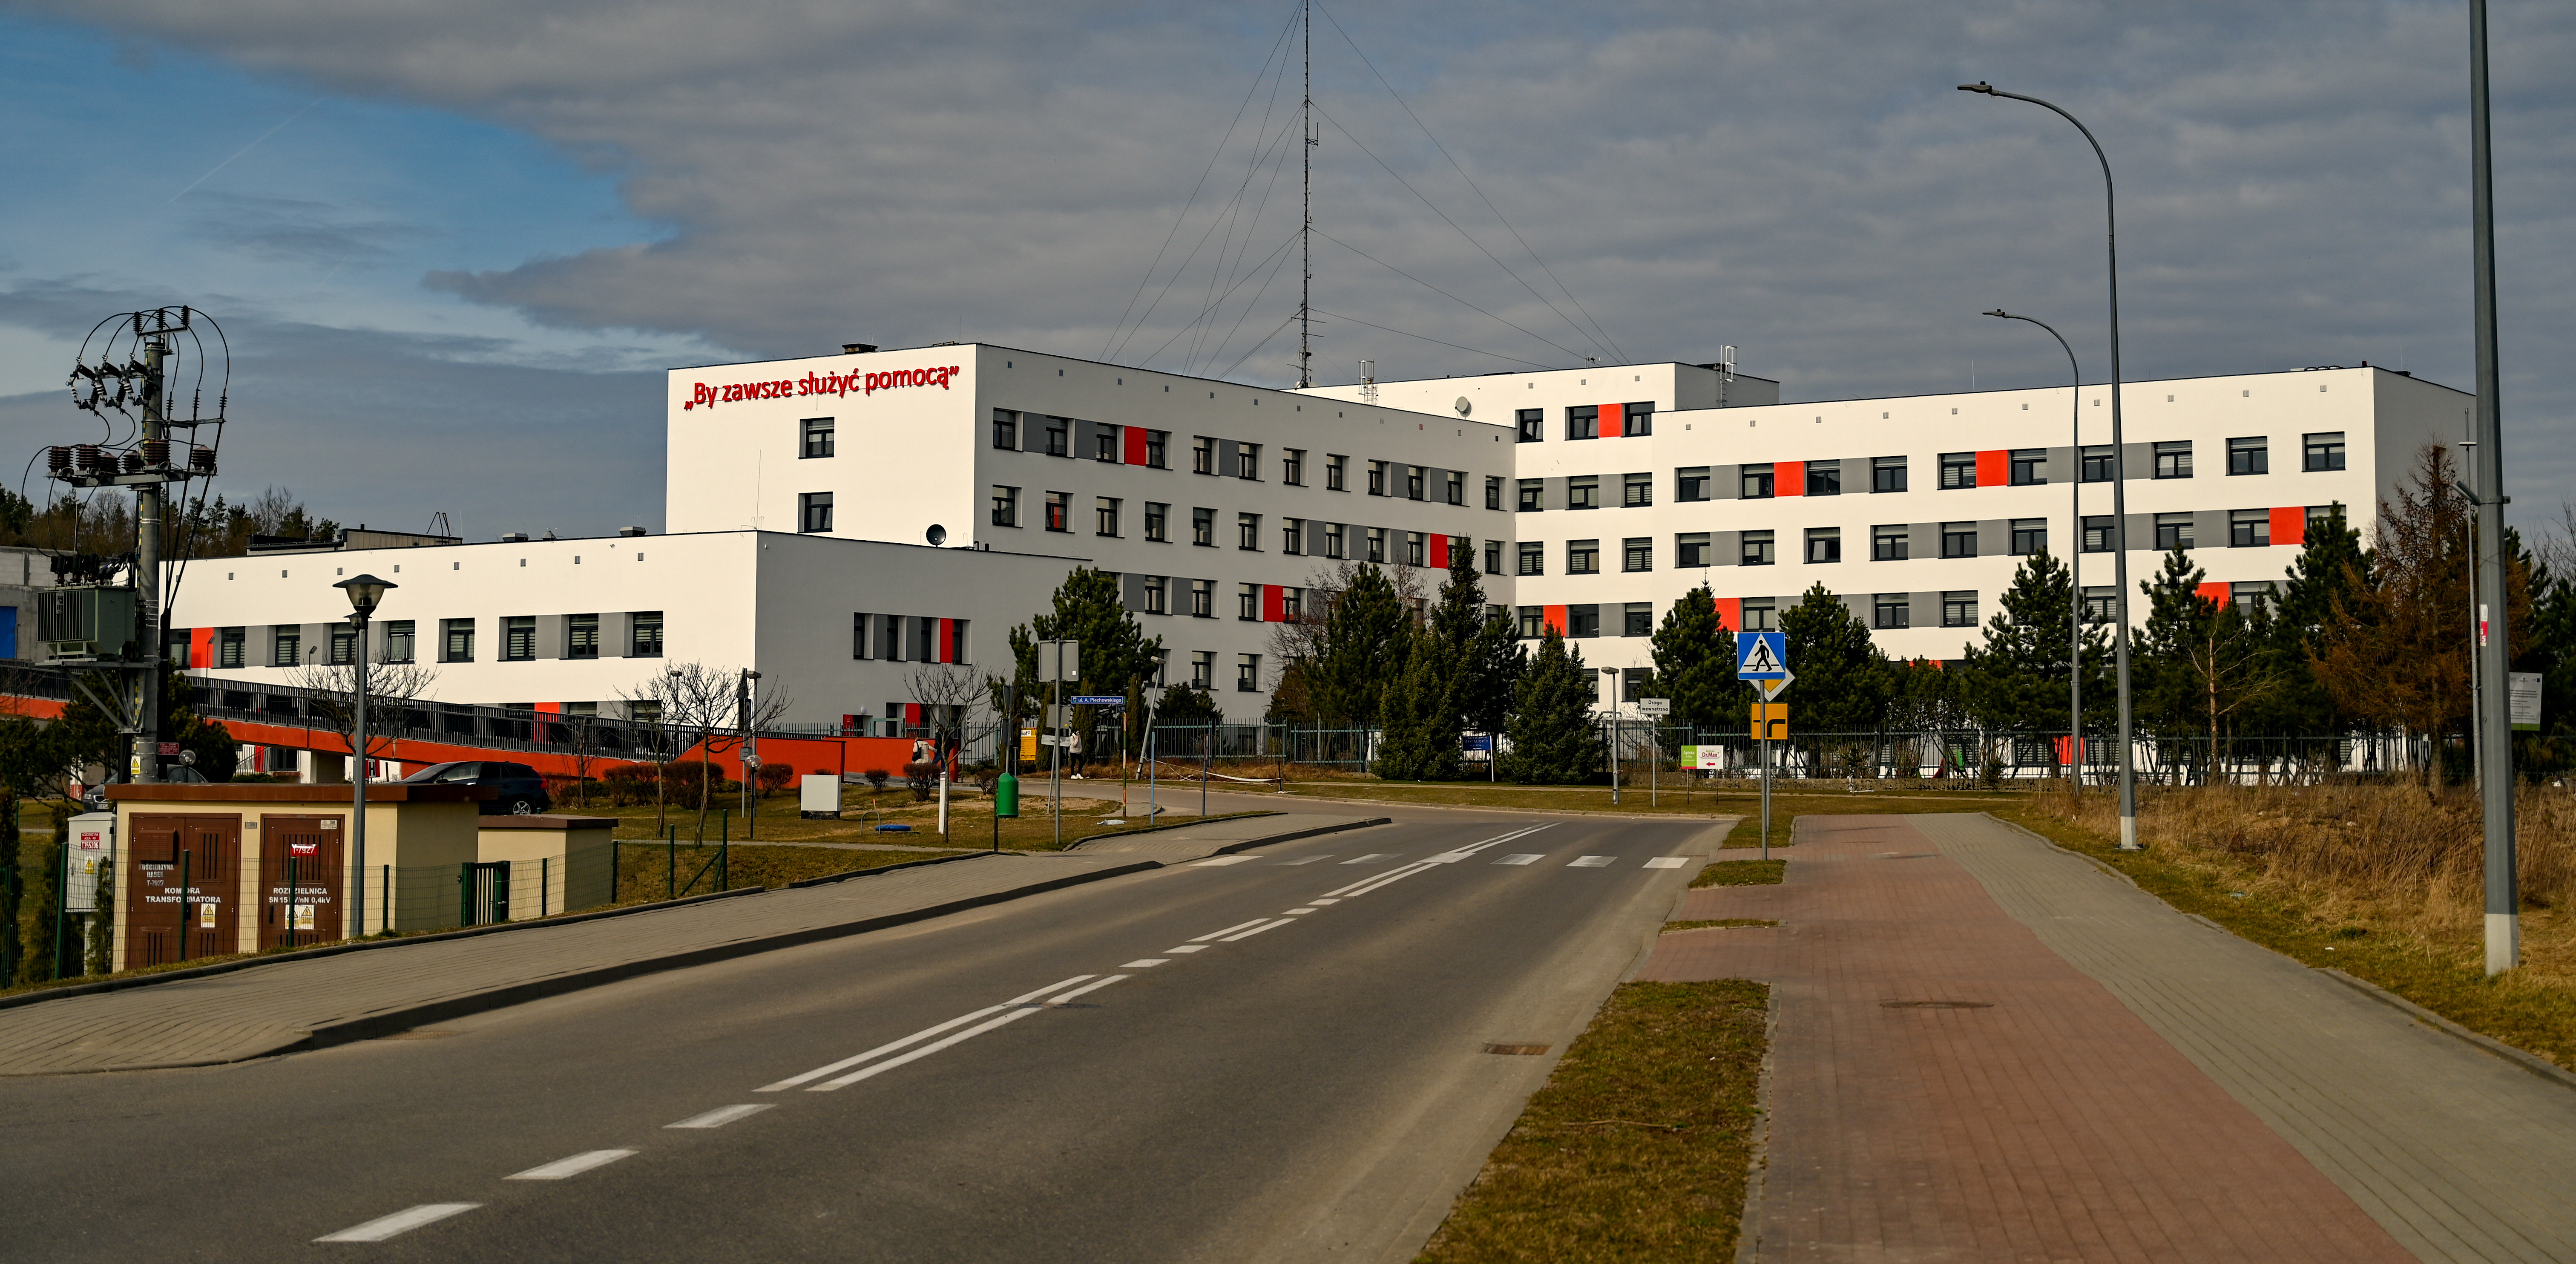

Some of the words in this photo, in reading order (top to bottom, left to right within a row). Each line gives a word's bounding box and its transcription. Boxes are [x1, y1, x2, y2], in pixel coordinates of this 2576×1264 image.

[722, 380, 793, 402] zawsze
[798, 368, 859, 397] służyć
[368, 761, 375, 776] H
